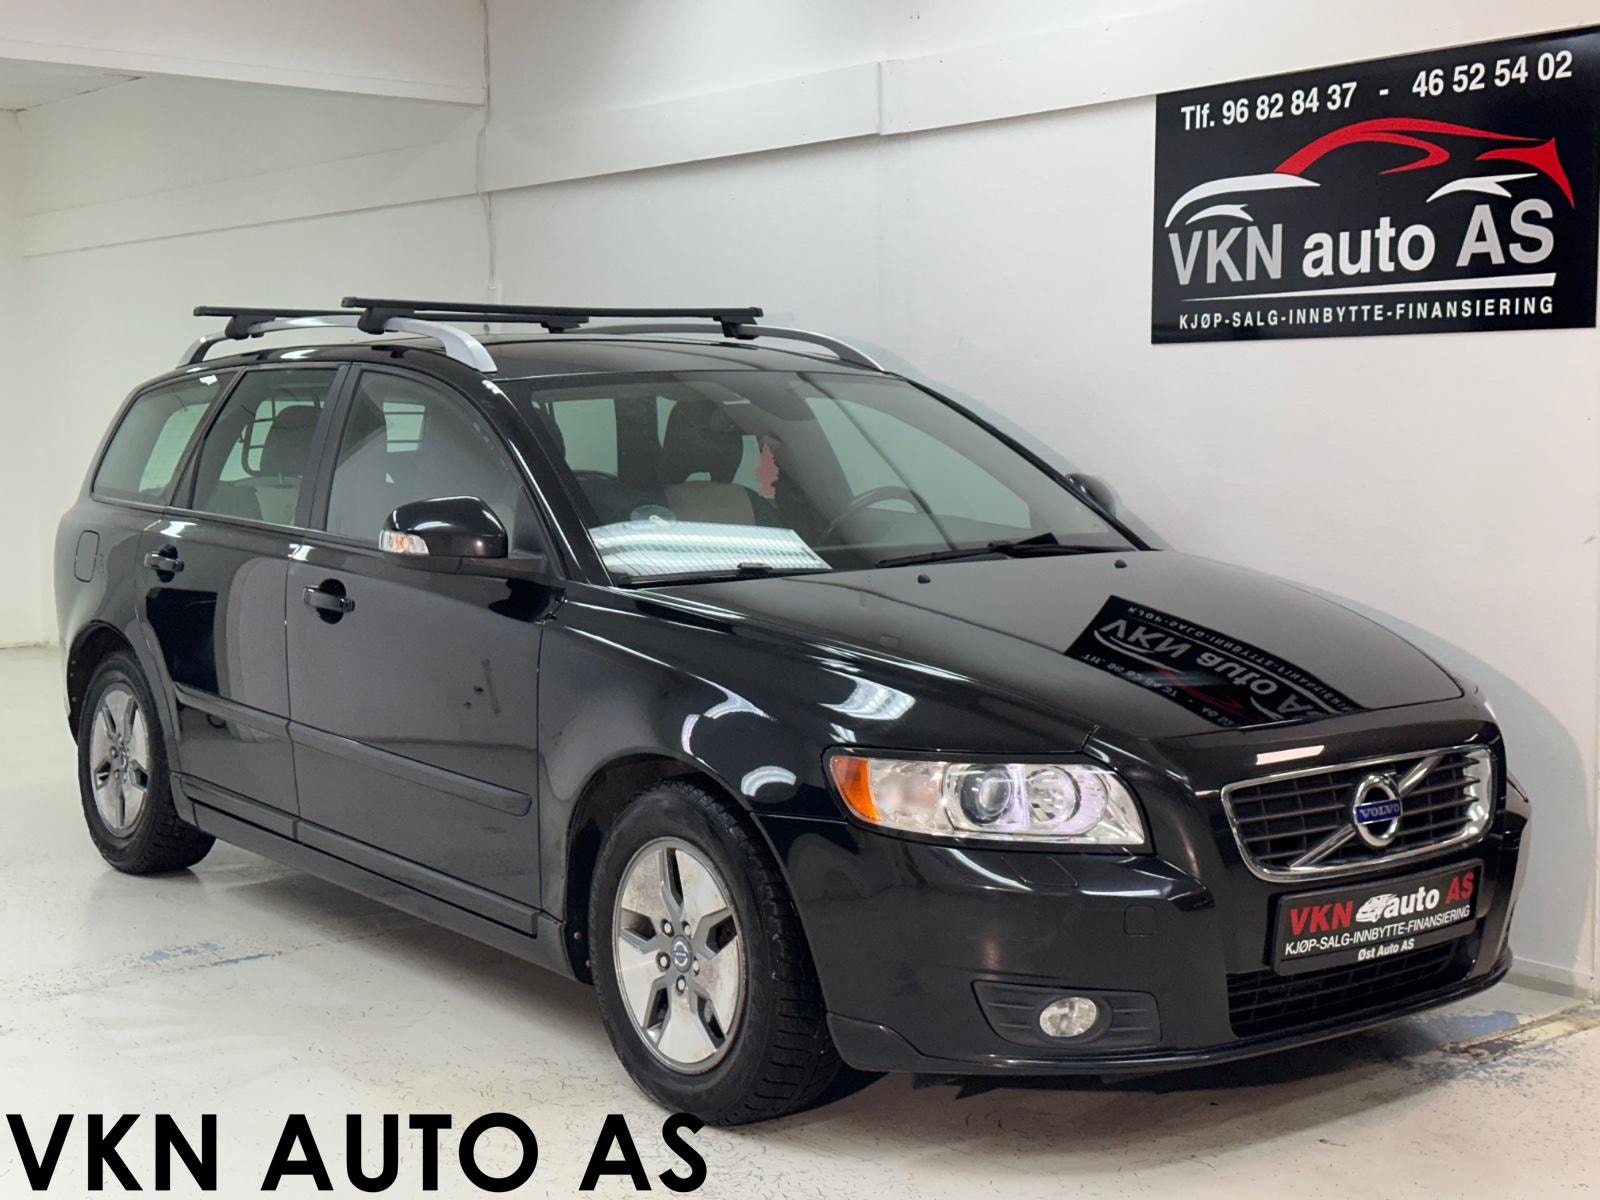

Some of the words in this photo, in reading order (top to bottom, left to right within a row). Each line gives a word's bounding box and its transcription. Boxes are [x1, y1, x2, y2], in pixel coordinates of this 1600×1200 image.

[1181, 104, 1215, 131] Tlf.
[1222, 98, 1249, 125] 96
[1255, 94, 1283, 122] 82
[1290, 88, 1319, 116] 84
[1326, 81, 1358, 111] 37
[1412, 68, 1445, 98] 46
[1452, 62, 1485, 93] 52
[1494, 55, 1529, 88] 54
[1537, 50, 1572, 81] 02
[1168, 223, 1283, 286] VKN
[1302, 216, 1436, 278] auto
[1456, 198, 1555, 267] AS
[1179, 296, 1554, 331] KJØP-SALG-INNBYTTE-FINANSIERING
[1359, 803, 1399, 818] VOLVO
[1290, 900, 1353, 936] VKN
[1384, 886, 1440, 919] auto
[1445, 871, 1475, 904] AS
[1285, 904, 1471, 956] KJØP-SALG-INNBYTTE-FINANSIERING
[1357, 947, 1376, 962] Øst
[1377, 943, 1400, 957] Auto
[1401, 938, 1415, 952] AS
